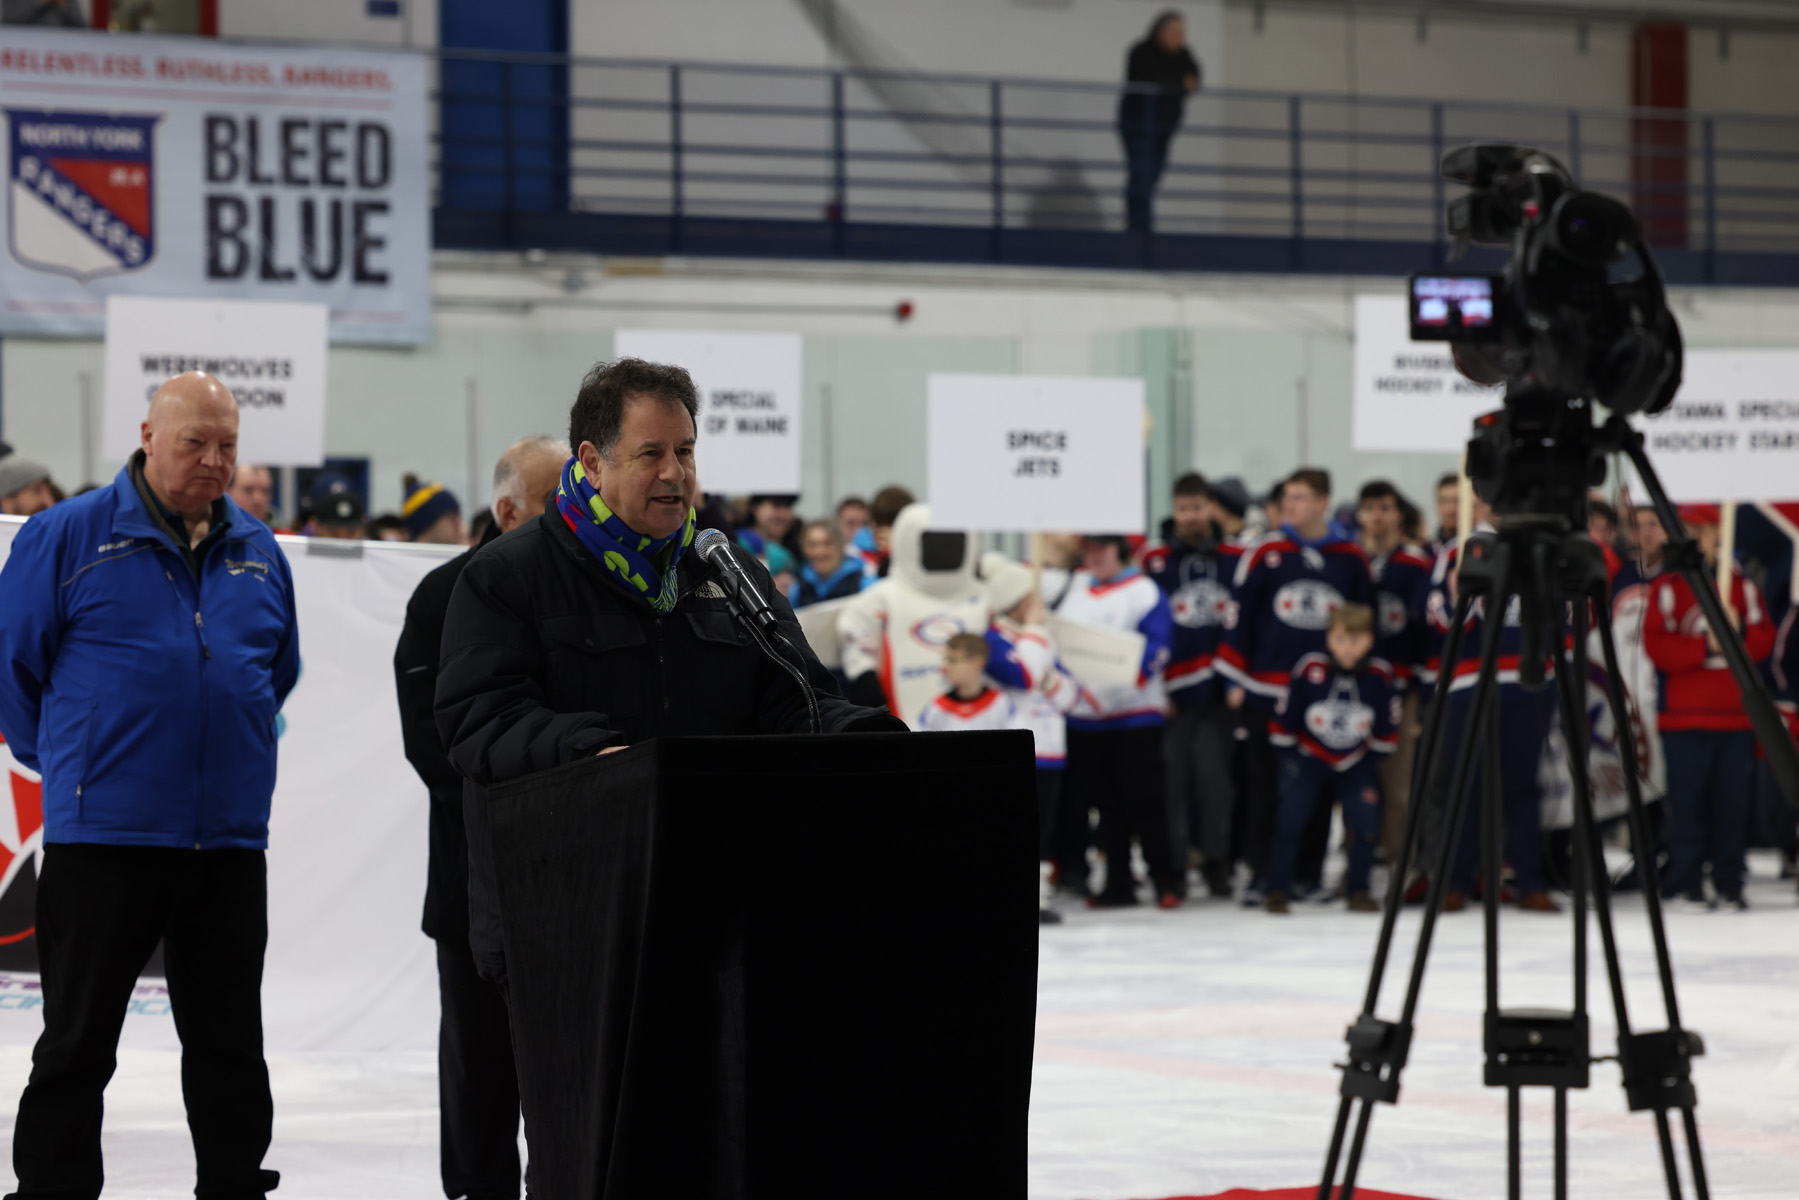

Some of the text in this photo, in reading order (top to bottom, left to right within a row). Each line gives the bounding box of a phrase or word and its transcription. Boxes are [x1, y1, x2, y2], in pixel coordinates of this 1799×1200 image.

[20, 123, 145, 151] NORTH YORK
[205, 115, 391, 190] BLEED
[19, 156, 145, 265] RANGERS
[206, 195, 390, 287] BLUE
[140, 355, 293, 378] WEREWOLVES
[710, 389, 777, 410] SPECIAL
[706, 416, 788, 436] OF MAINE
[1007, 430, 1067, 451] SPICE
[1654, 432, 1736, 452] HOCKEY
[1013, 457, 1061, 479] JETS
